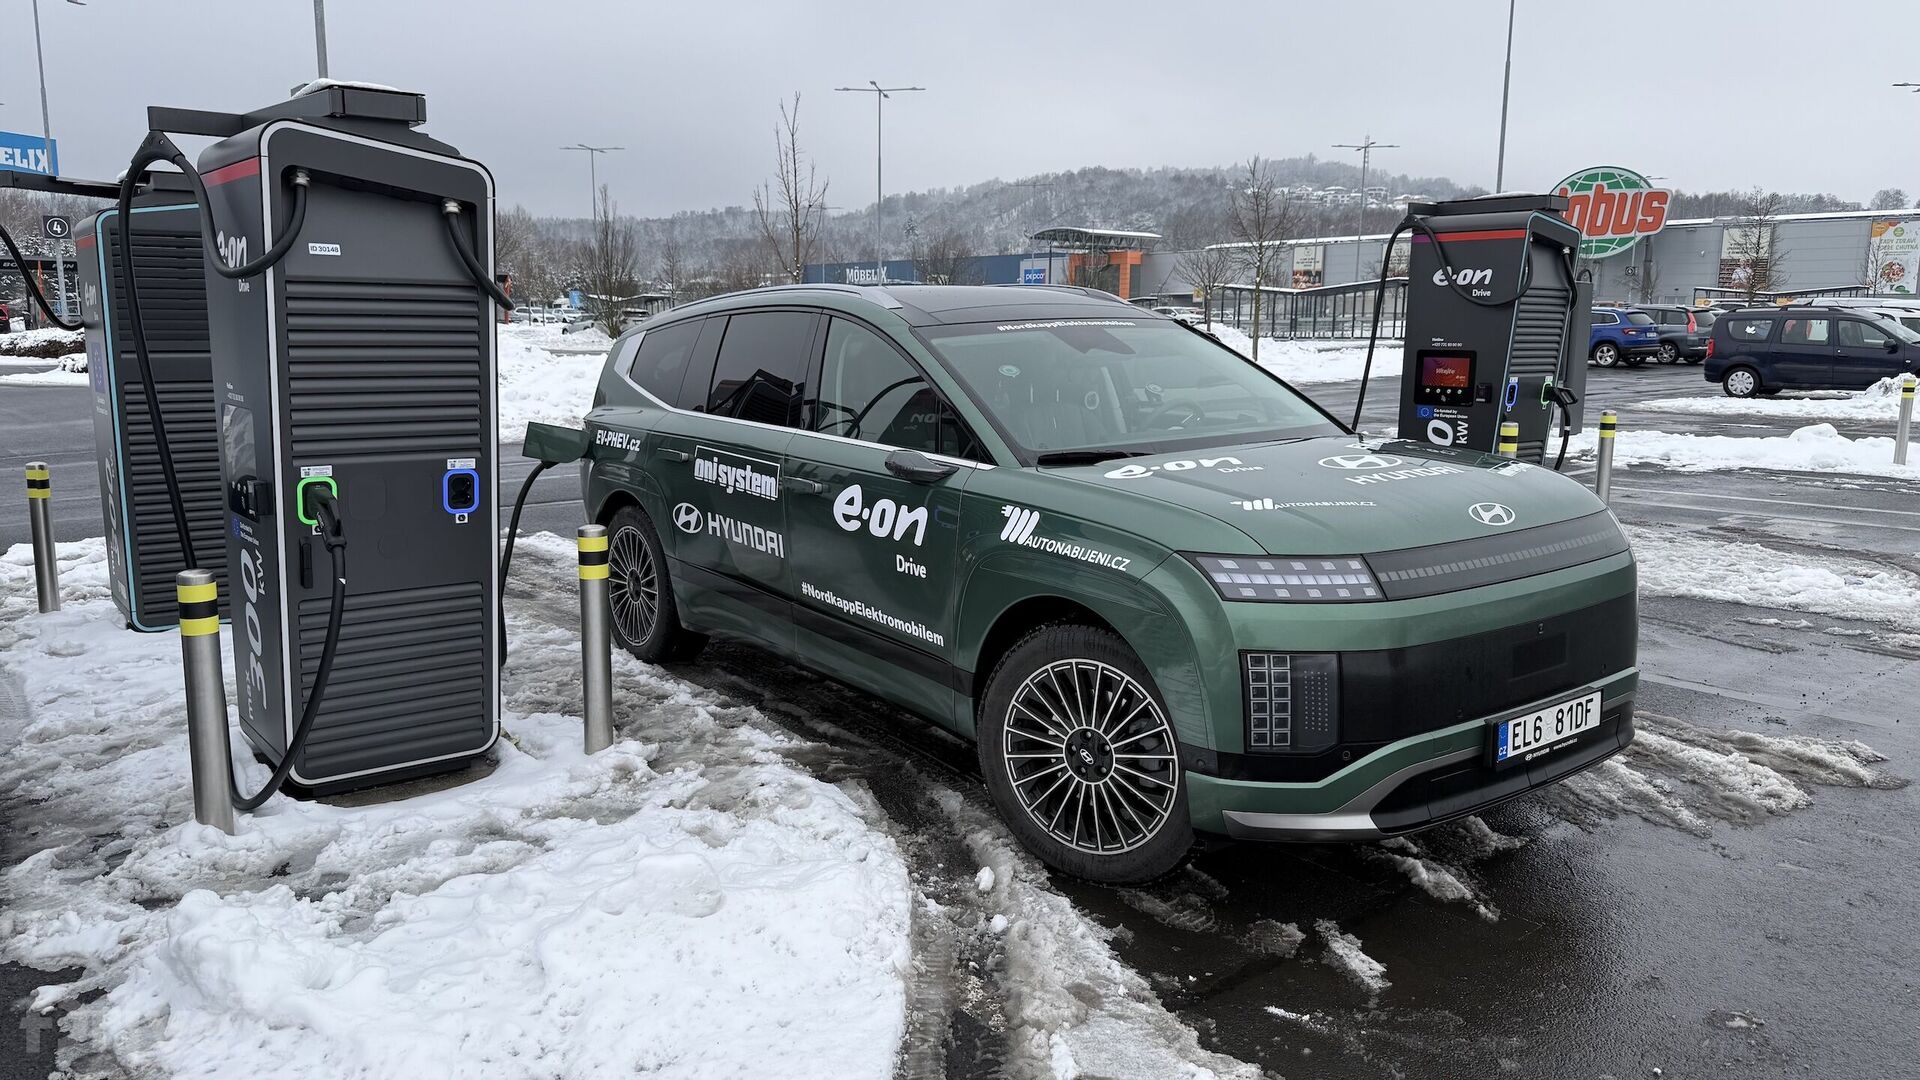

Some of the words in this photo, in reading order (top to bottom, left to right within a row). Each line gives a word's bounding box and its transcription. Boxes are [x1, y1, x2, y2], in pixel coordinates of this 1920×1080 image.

[53, 222, 62, 233] 4
[310, 244, 317, 252] ID
[318, 245, 339, 253] 30148
[846, 265, 887, 284] MÖBELIX
[1472, 288, 1491, 297] Drive
[595, 429, 641, 452] EV-PHEV.cz
[1455, 420, 1469, 444] kW
[1217, 464, 1265, 473] Drive
[1345, 465, 1465, 485] HYUNDAI
[707, 512, 785, 559] HYUNDAI
[1024, 535, 1131, 572] AUTONABIJENI.CZ
[255, 549, 266, 596] kW
[896, 554, 927, 578] Drive
[801, 581, 944, 647] #NordkappElektromobilem
[240, 549, 267, 710] 300
[245, 669, 254, 721] max
[1512, 715, 1542, 751] EL6
[1555, 697, 1594, 735] 81DF
[1498, 745, 1507, 756] CZ
